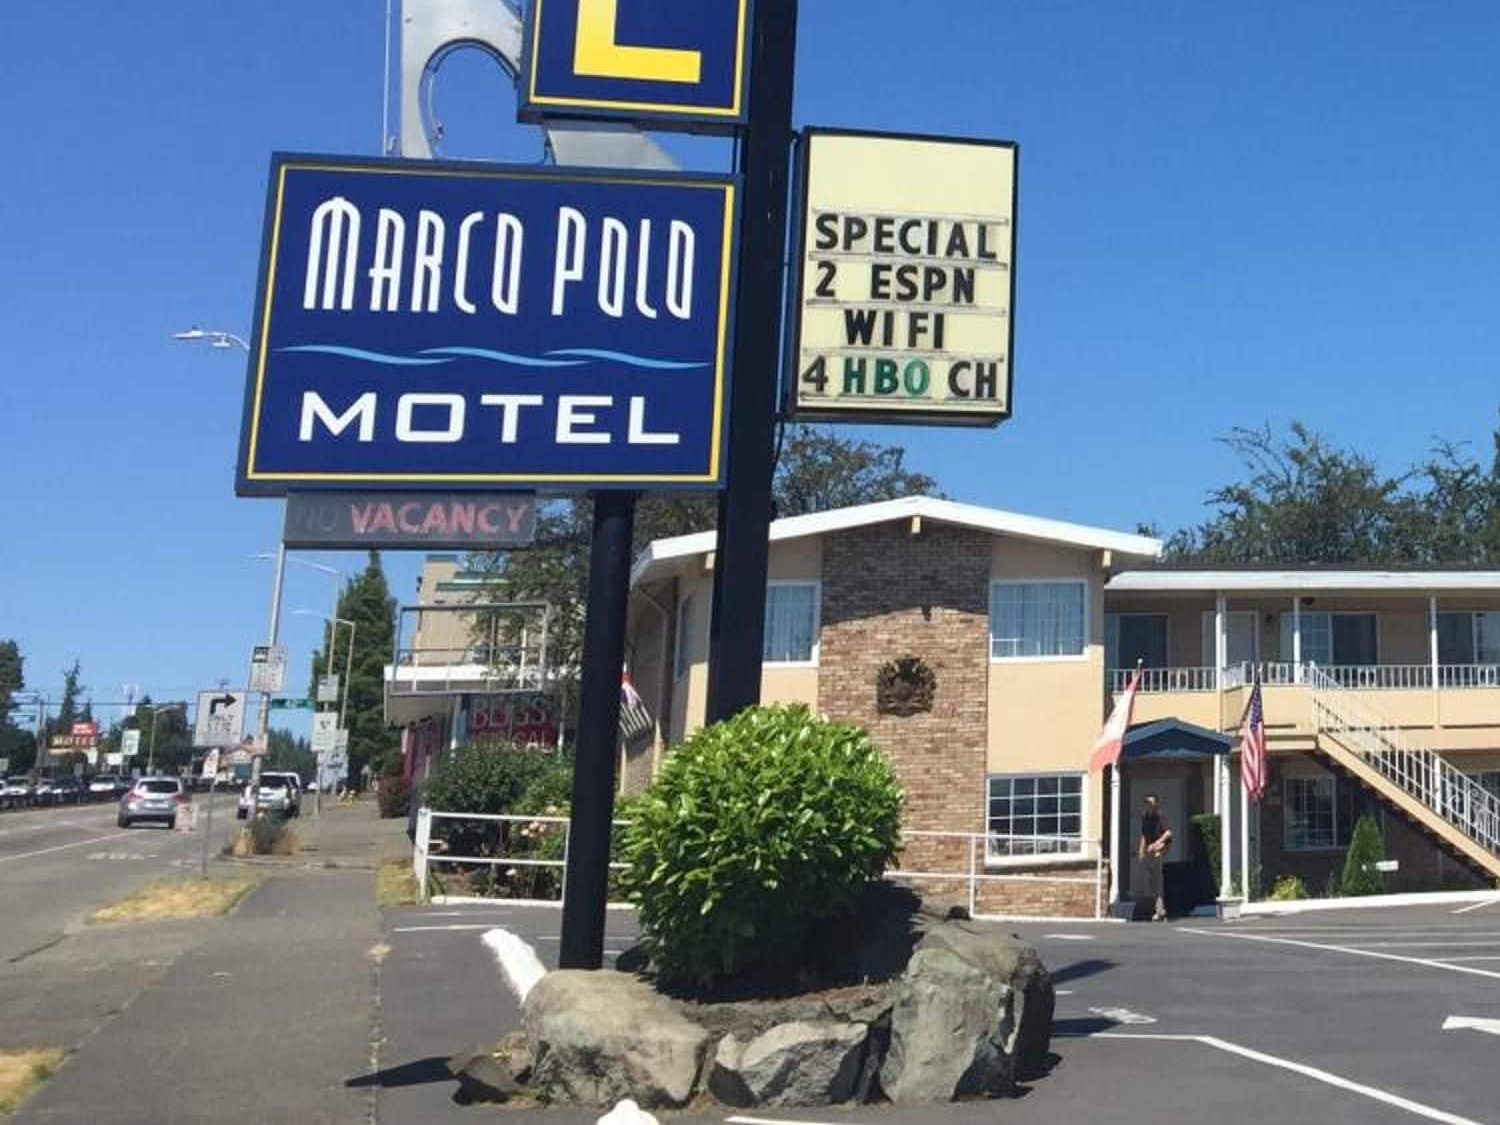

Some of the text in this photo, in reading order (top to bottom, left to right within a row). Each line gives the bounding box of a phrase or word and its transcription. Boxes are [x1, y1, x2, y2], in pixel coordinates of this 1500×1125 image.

[303, 196, 696, 320] MARCO POLO
[814, 213, 997, 260] SPECIAL
[814, 260, 975, 304] 2 ESPN
[802, 355, 997, 398] 4 HBO CH
[299, 391, 680, 445] MOTEL
[351, 502, 529, 535] VACANCY
